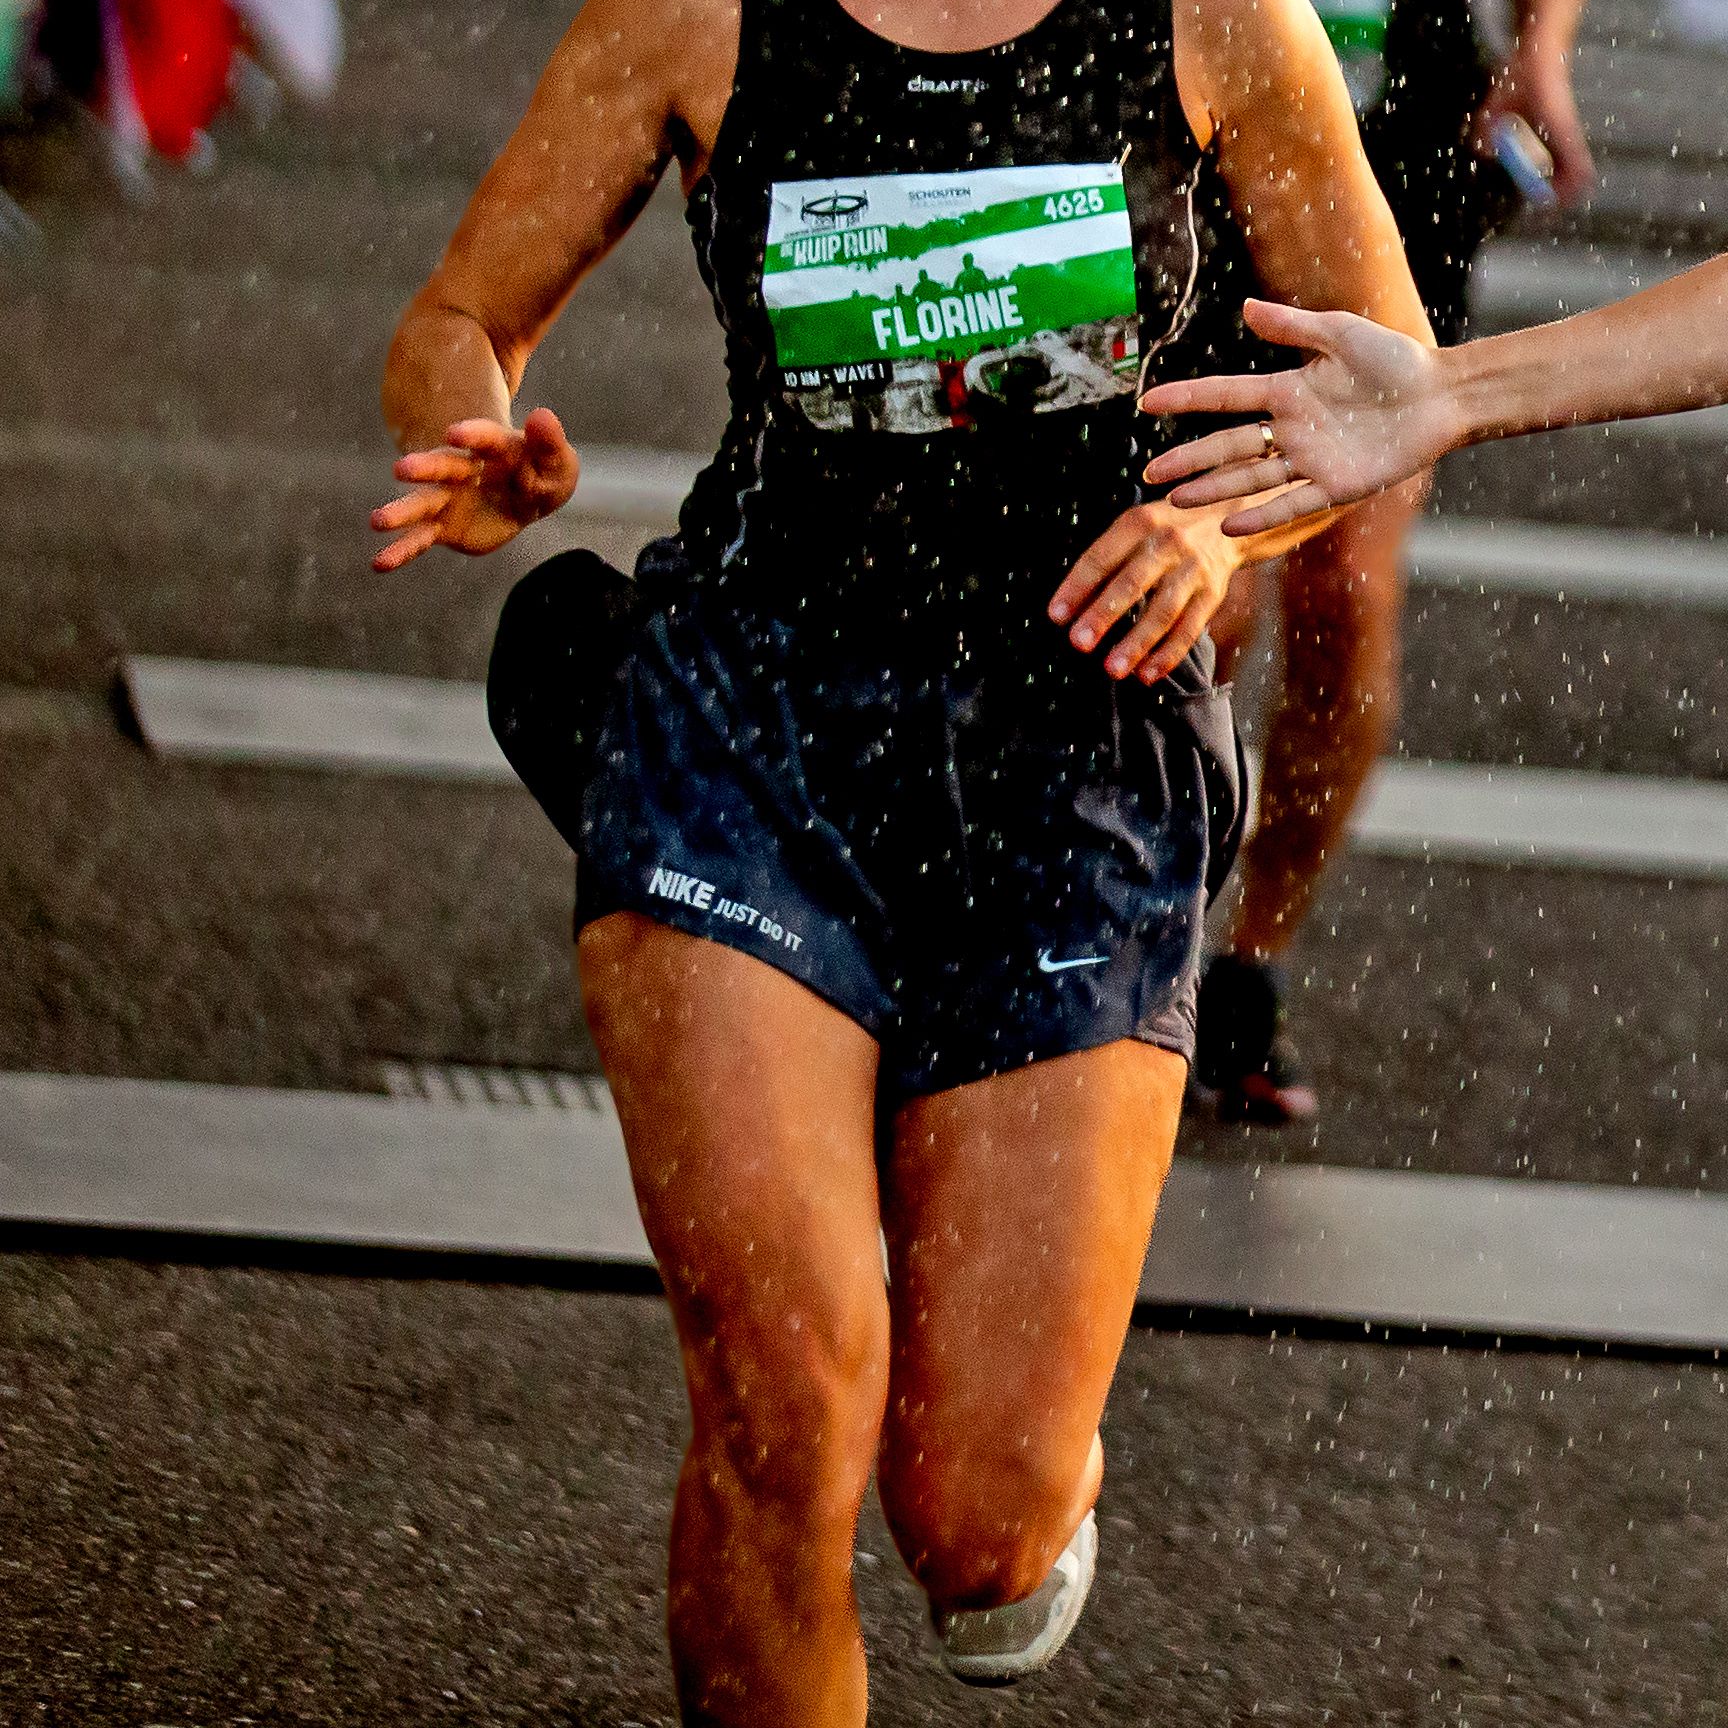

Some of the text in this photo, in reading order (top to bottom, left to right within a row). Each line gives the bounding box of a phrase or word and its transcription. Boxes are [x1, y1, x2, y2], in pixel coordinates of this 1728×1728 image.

[1043, 187, 1104, 221] 4625
[793, 234, 841, 266] KUIP
[842, 226, 888, 259] RUN
[871, 285, 1024, 350] FLORINE
[833, 363, 875, 384] WAVE
[648, 867, 804, 952] NIKE JUST DO IT
